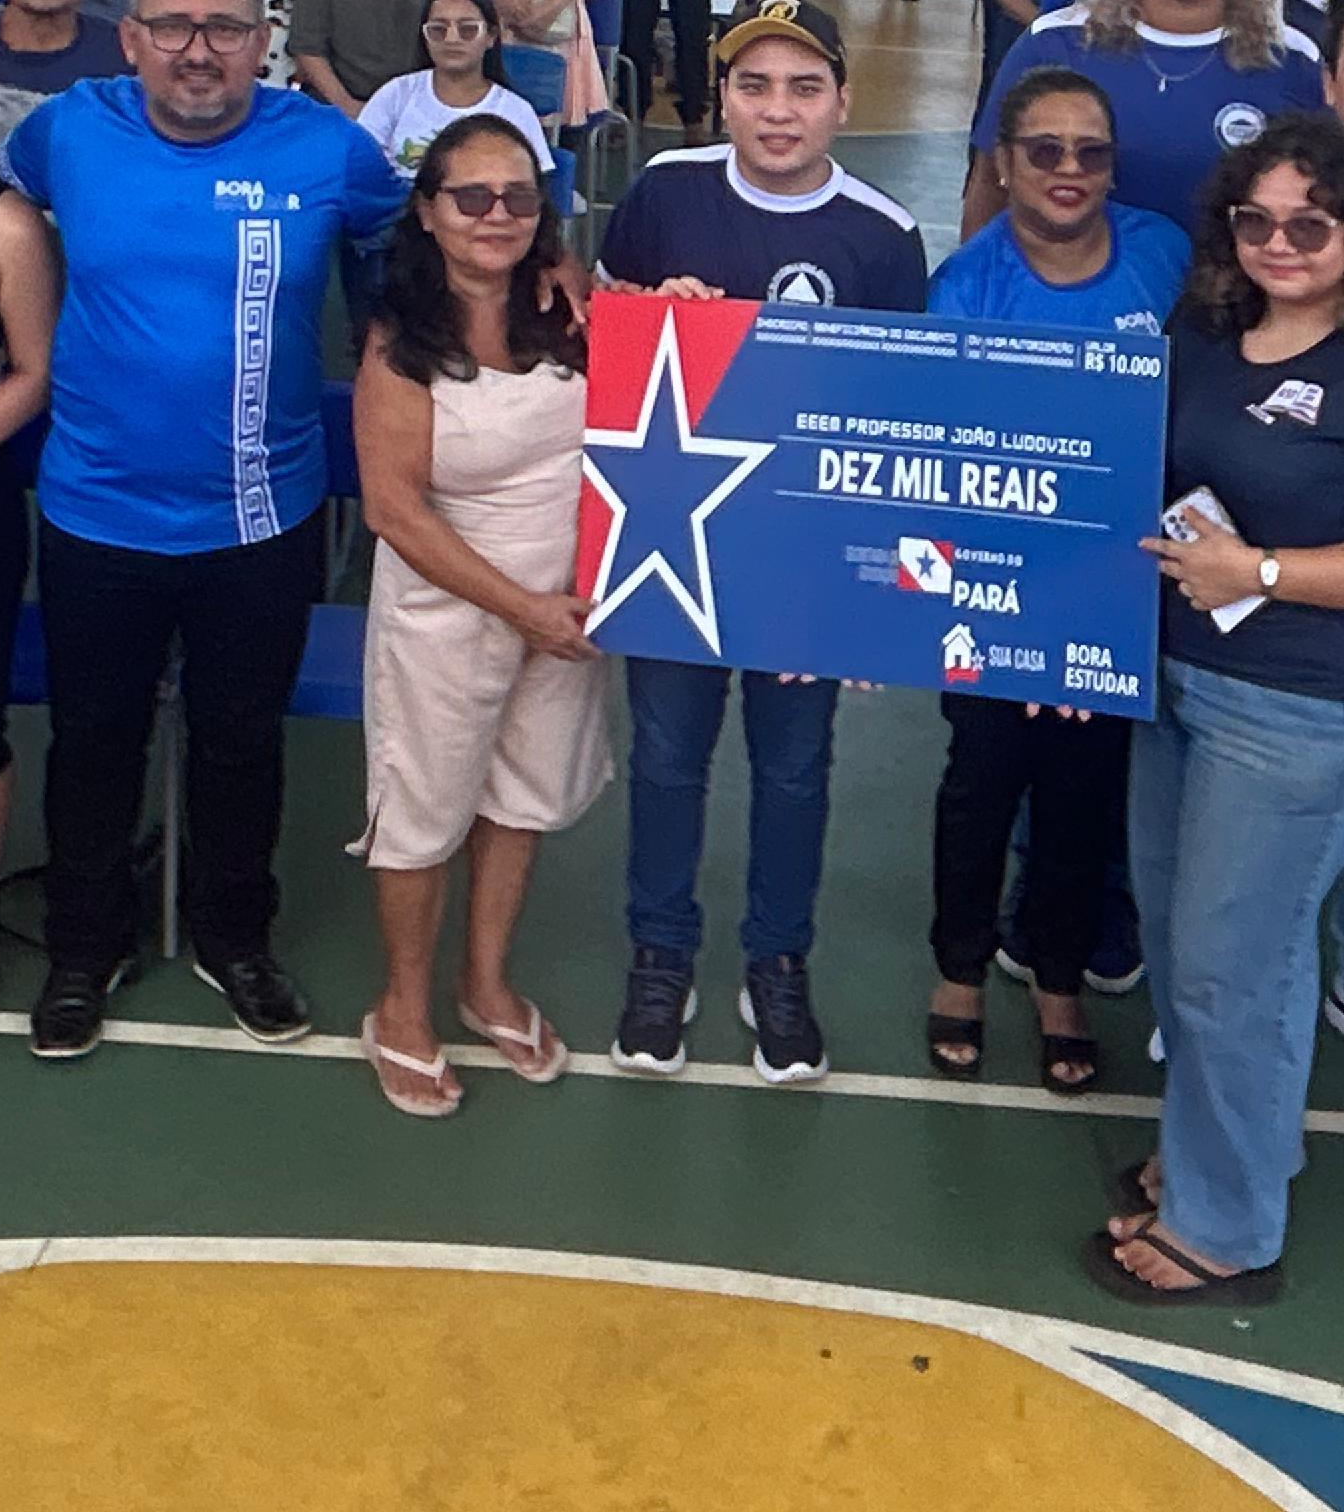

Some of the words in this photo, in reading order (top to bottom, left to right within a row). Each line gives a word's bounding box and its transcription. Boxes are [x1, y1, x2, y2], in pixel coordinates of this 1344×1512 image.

[215, 180, 264, 195] BORA
[1084, 352, 1104, 372] R$
[1109, 355, 1161, 377] 10.000
[846, 417, 945, 442] PROFESSOR
[951, 426, 995, 448] JOÃO
[1001, 434, 1092, 458] LUDOVICO
[818, 448, 883, 496] DEZ
[891, 455, 950, 502] MIL
[960, 461, 1058, 515] REAIS
[952, 578, 1020, 615] PARÁ
[1066, 642, 1112, 668] BORA
[1064, 666, 1140, 697] ESTUDAR
